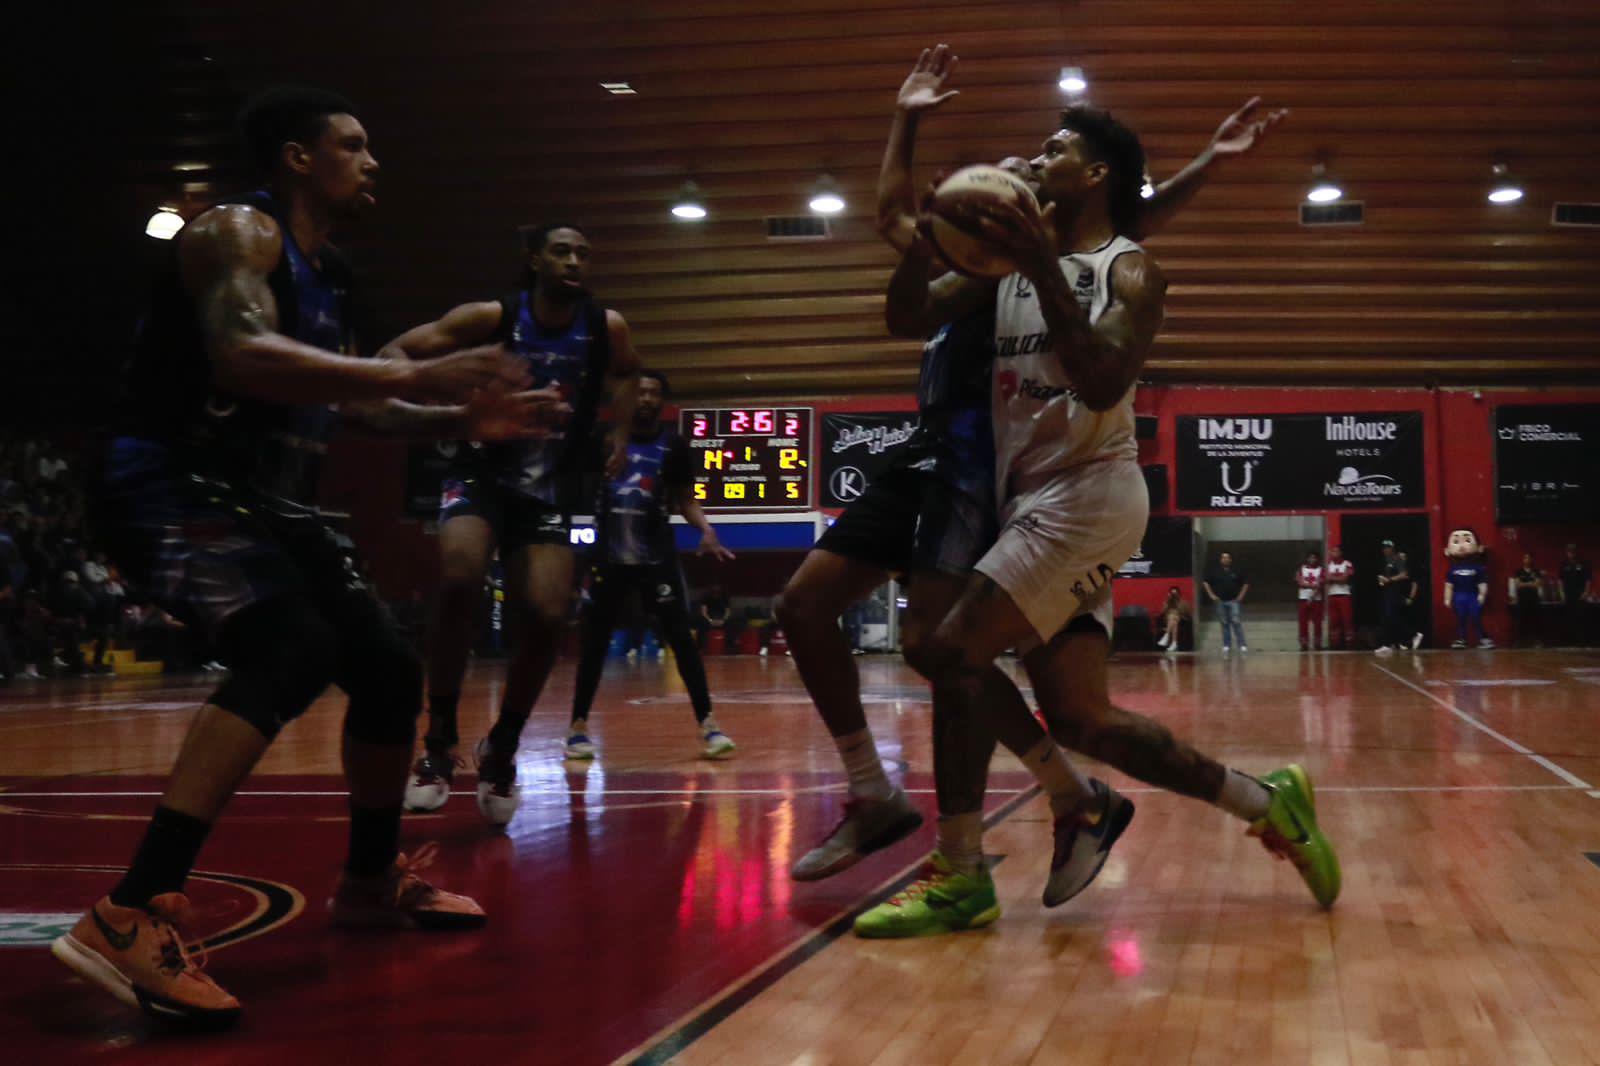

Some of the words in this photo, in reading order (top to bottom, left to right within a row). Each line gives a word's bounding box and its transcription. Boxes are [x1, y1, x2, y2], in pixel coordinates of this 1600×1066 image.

[693, 420, 706, 436] 2
[785, 419, 798, 435] 2
[1198, 418, 1272, 440] IMJU
[1325, 415, 1397, 441] InHouse
[786, 482, 799, 499] 5
[840, 471, 861, 497] K
[1210, 496, 1263, 507] RULER
